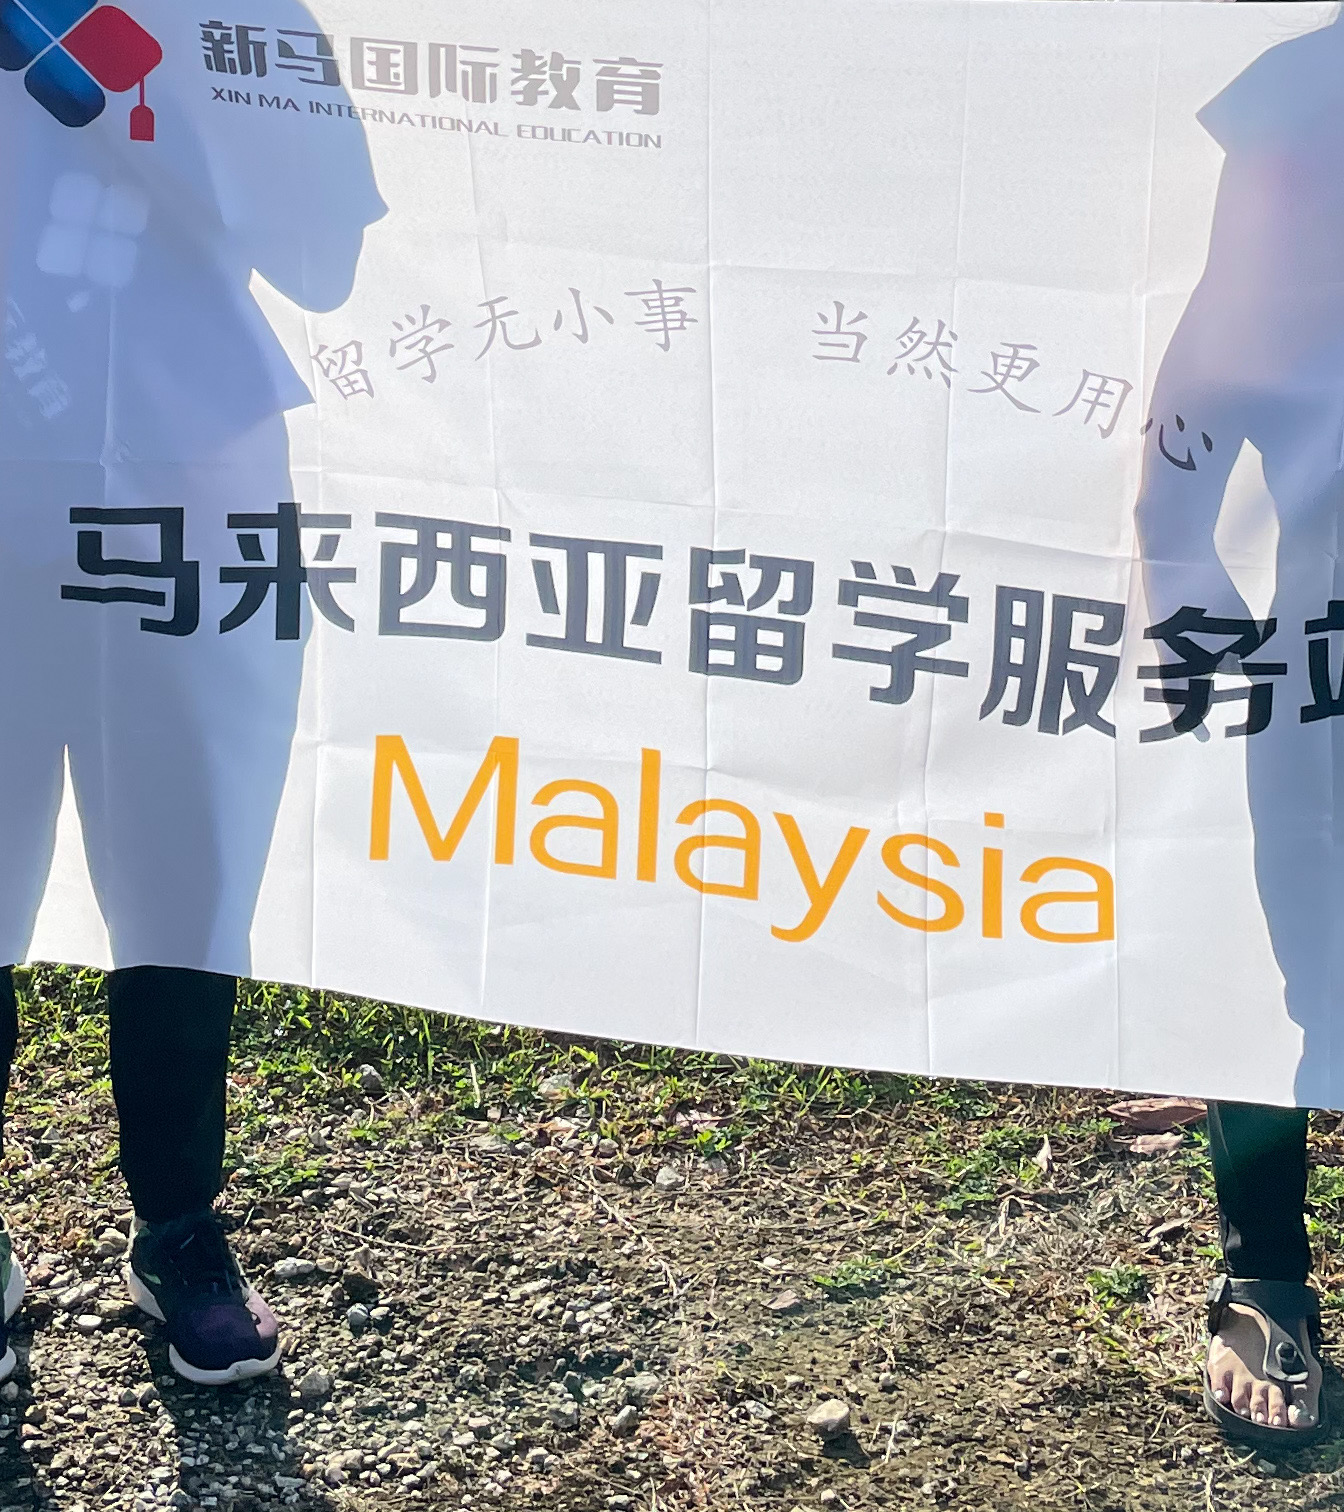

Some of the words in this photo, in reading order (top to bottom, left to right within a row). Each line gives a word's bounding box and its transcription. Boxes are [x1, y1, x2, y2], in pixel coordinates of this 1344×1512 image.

[199, 19, 664, 117] 新马国际教育
[210, 86, 253, 107] XIN
[258, 95, 301, 113] MA
[308, 101, 507, 137] INTERNATIONAL
[516, 124, 663, 149] EDUCATION
[312, 278, 699, 401] 留学无小事
[809, 298, 1215, 472] 当然更用心
[368, 733, 1117, 945] Malaysia
